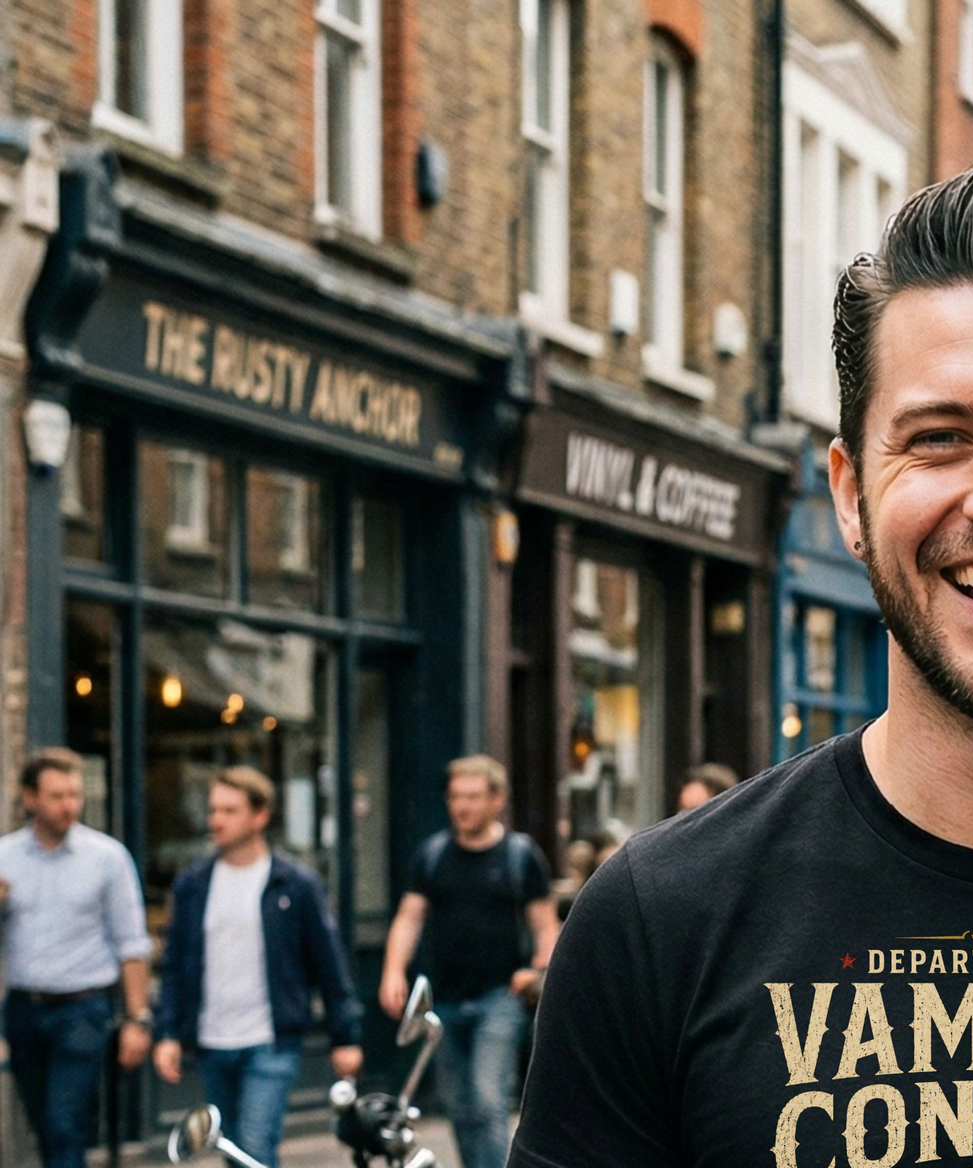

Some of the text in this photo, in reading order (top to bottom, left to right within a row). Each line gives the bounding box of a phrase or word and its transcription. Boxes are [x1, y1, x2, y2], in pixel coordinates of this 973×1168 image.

[143, 302, 422, 446] THE RUSTY ANCHOR
[566, 430, 741, 541] VINYL & COFFEE
